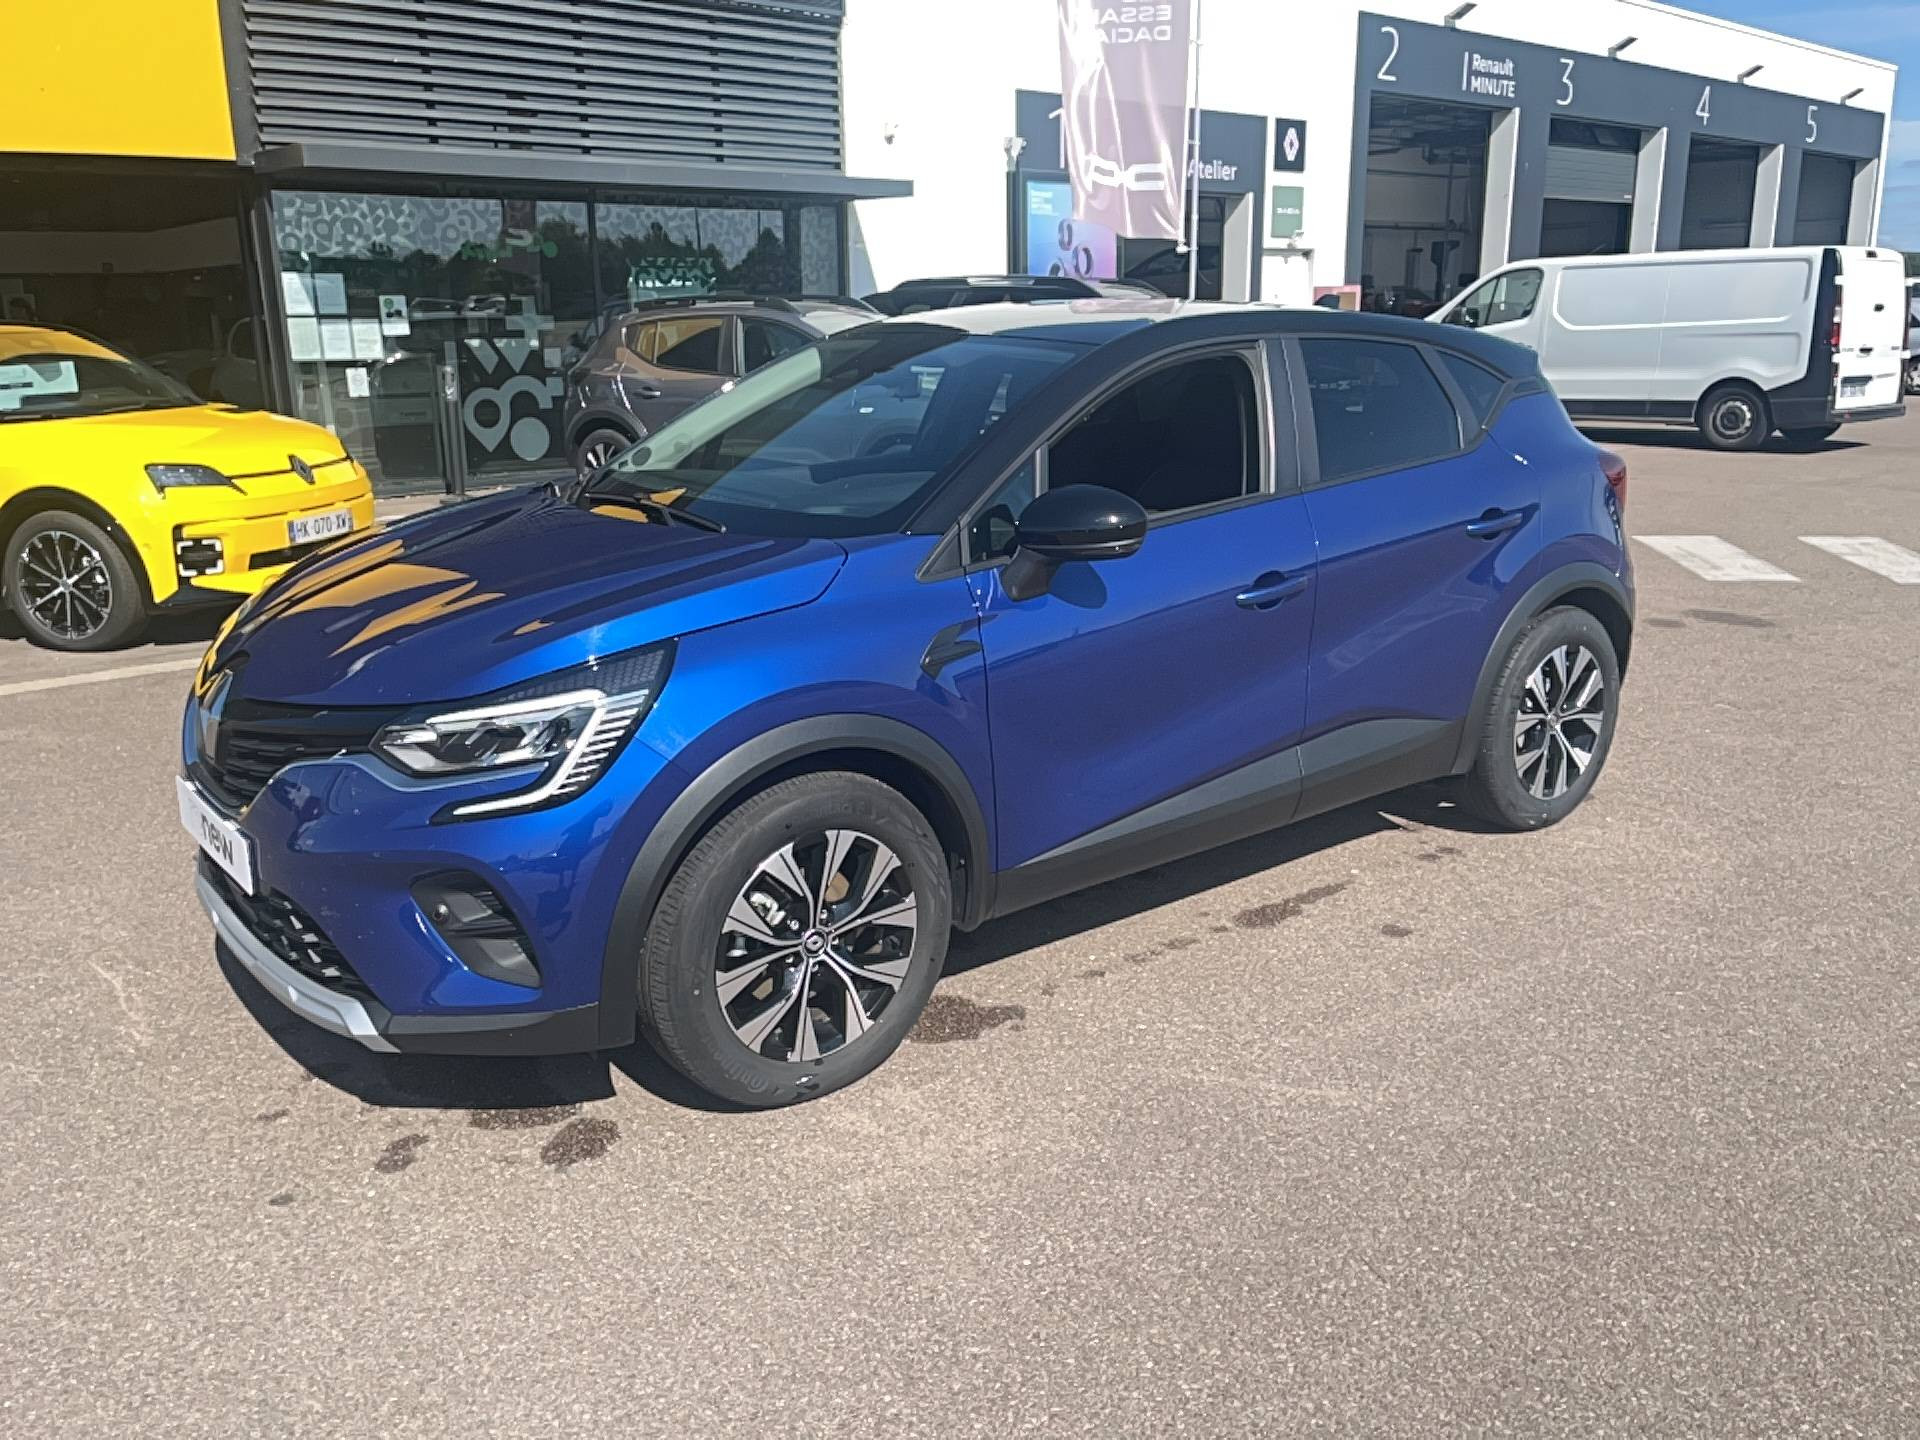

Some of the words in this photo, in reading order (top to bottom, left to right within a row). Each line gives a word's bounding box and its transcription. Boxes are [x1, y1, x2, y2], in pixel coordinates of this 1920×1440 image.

[1377, 26, 1399, 81] 2
[1472, 54, 1514, 77] Renault
[1470, 76, 1516, 98] MINUTE
[1556, 58, 1575, 106] 3
[1695, 86, 1711, 126] 4
[1805, 105, 1818, 143] 5
[1187, 159, 1238, 181] Atelier
[201, 813, 234, 866] new
